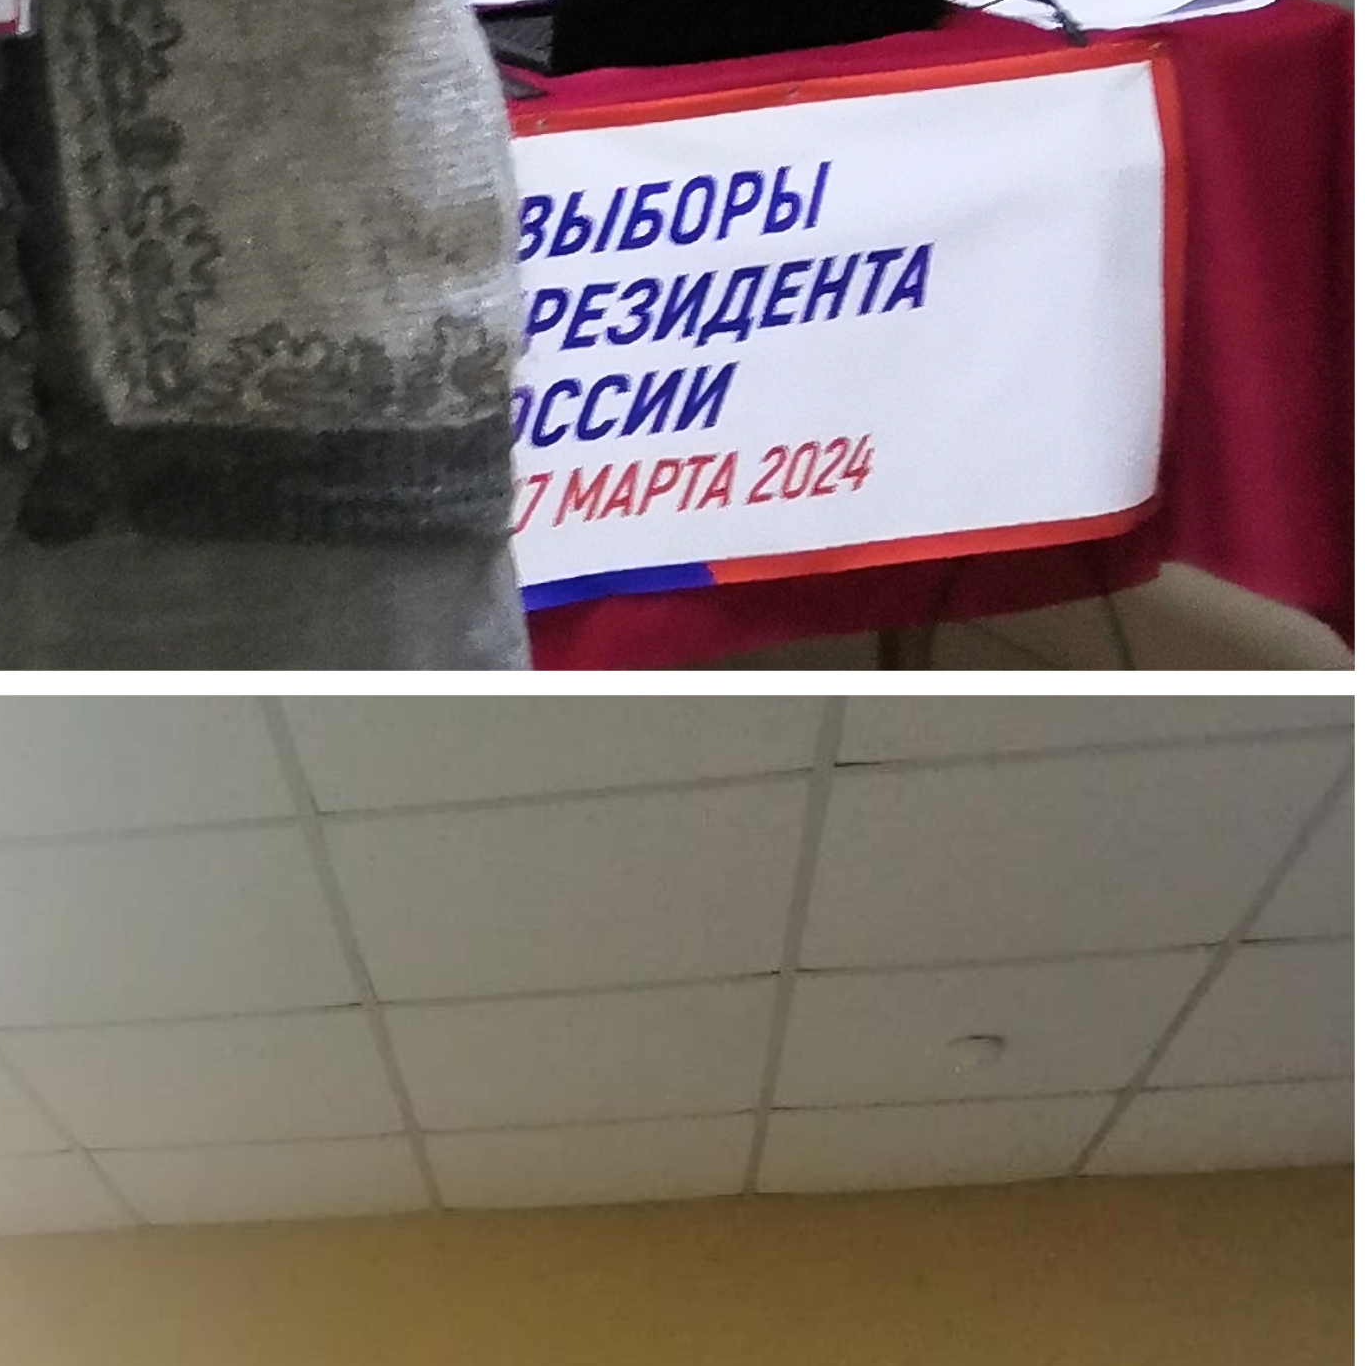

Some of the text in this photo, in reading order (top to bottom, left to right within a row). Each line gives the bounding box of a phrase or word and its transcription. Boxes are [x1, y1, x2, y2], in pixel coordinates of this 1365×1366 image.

[518, 159, 832, 264] ВЫБОРЫ
[521, 241, 936, 354] РЕЗИДЕНТА
[552, 447, 739, 527] МАРТА
[743, 433, 875, 505] 2024
